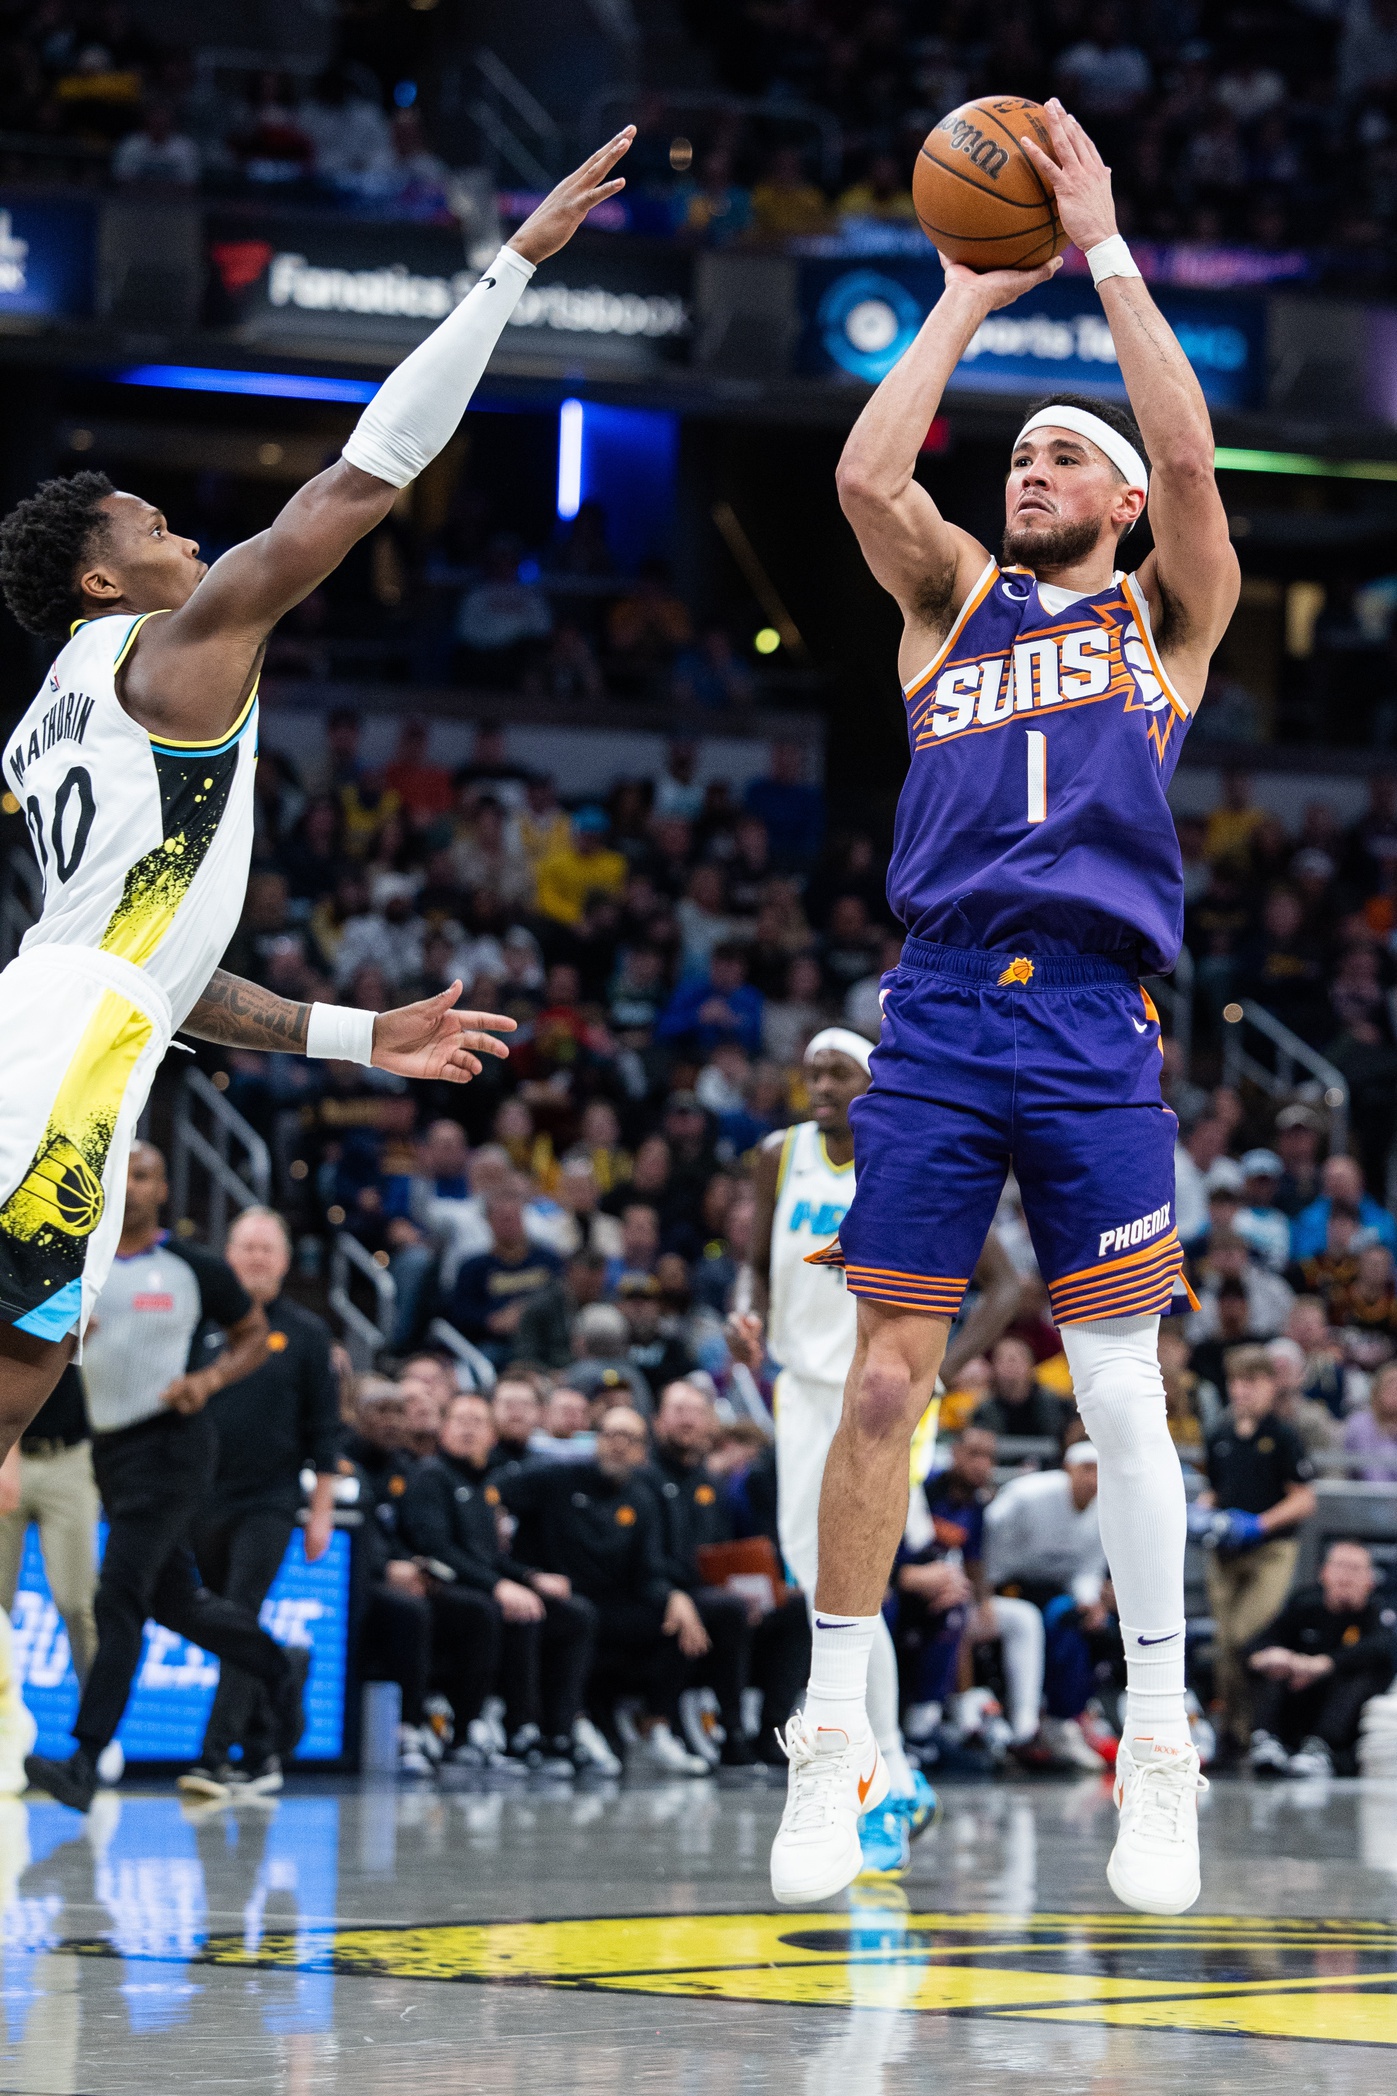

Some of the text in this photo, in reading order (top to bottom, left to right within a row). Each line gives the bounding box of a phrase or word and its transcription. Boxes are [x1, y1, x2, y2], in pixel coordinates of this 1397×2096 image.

[936, 114, 1010, 181] Wilso
[269, 253, 452, 318] Fanatics
[959, 313, 1075, 362] ports
[931, 628, 1110, 737] SUNS
[9, 692, 96, 788] MATHURIN
[1026, 730, 1047, 824] 1
[1098, 1201, 1171, 1257] PHOENIX
[1154, 1744, 1179, 1757] BOOK
